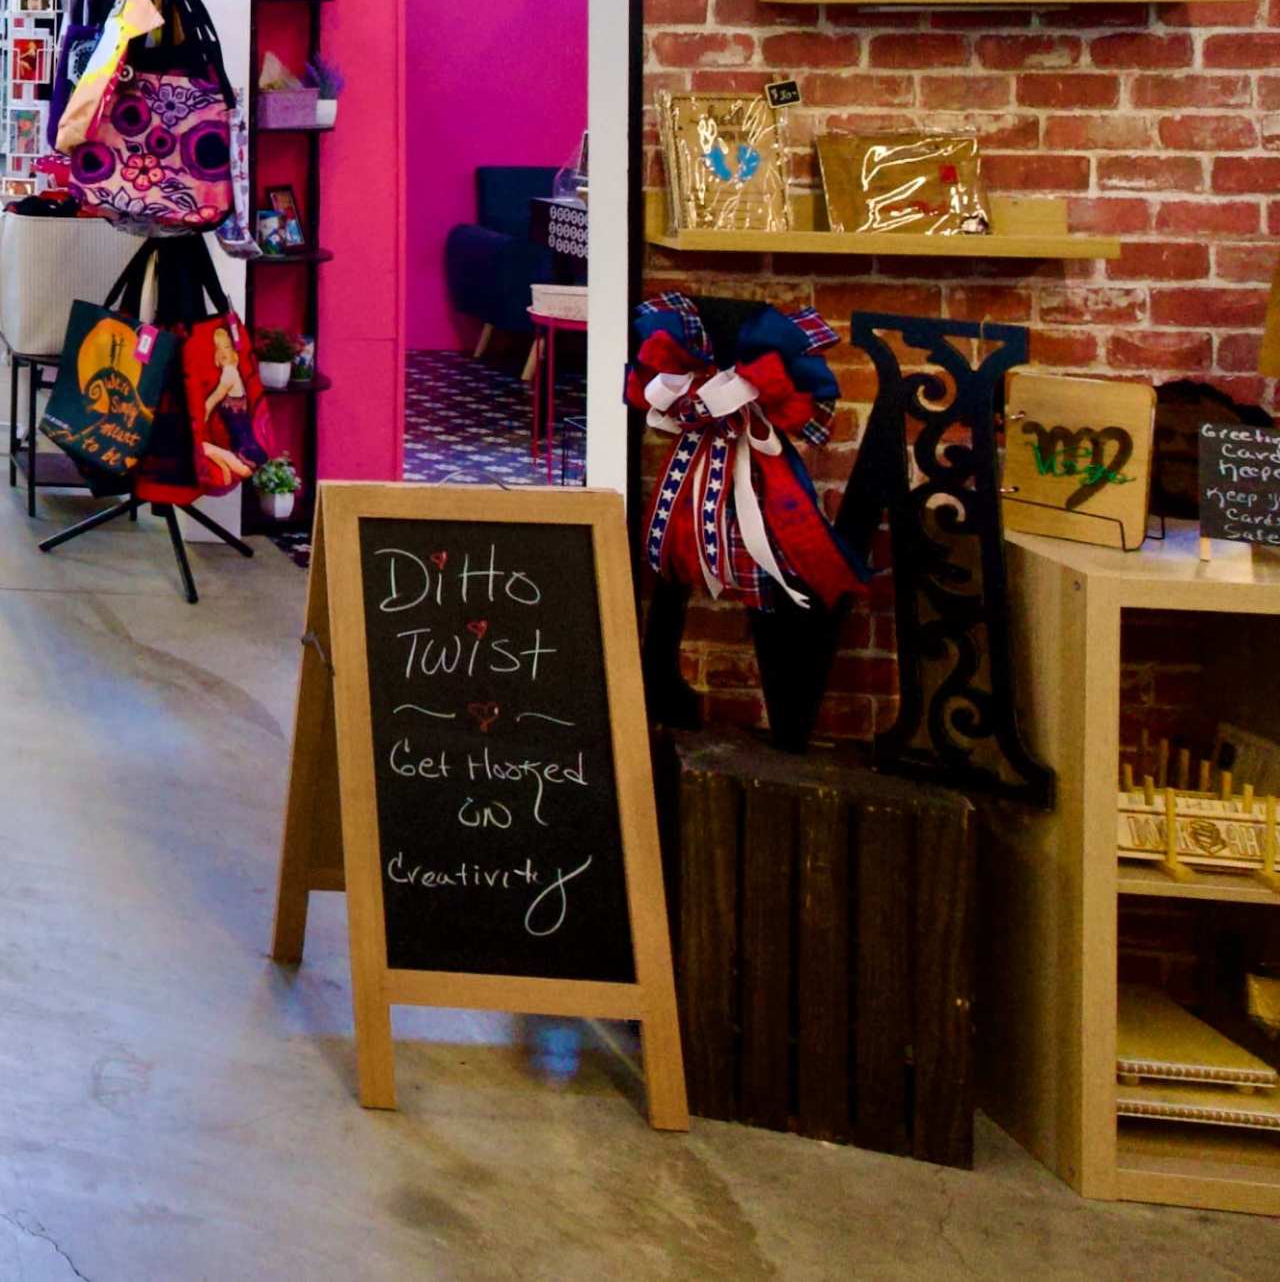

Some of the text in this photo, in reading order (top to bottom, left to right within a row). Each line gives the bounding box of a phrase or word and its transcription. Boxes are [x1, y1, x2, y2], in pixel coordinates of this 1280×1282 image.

[390, 738, 589, 826] Get Hooked
[387, 852, 593, 936] Creativity
